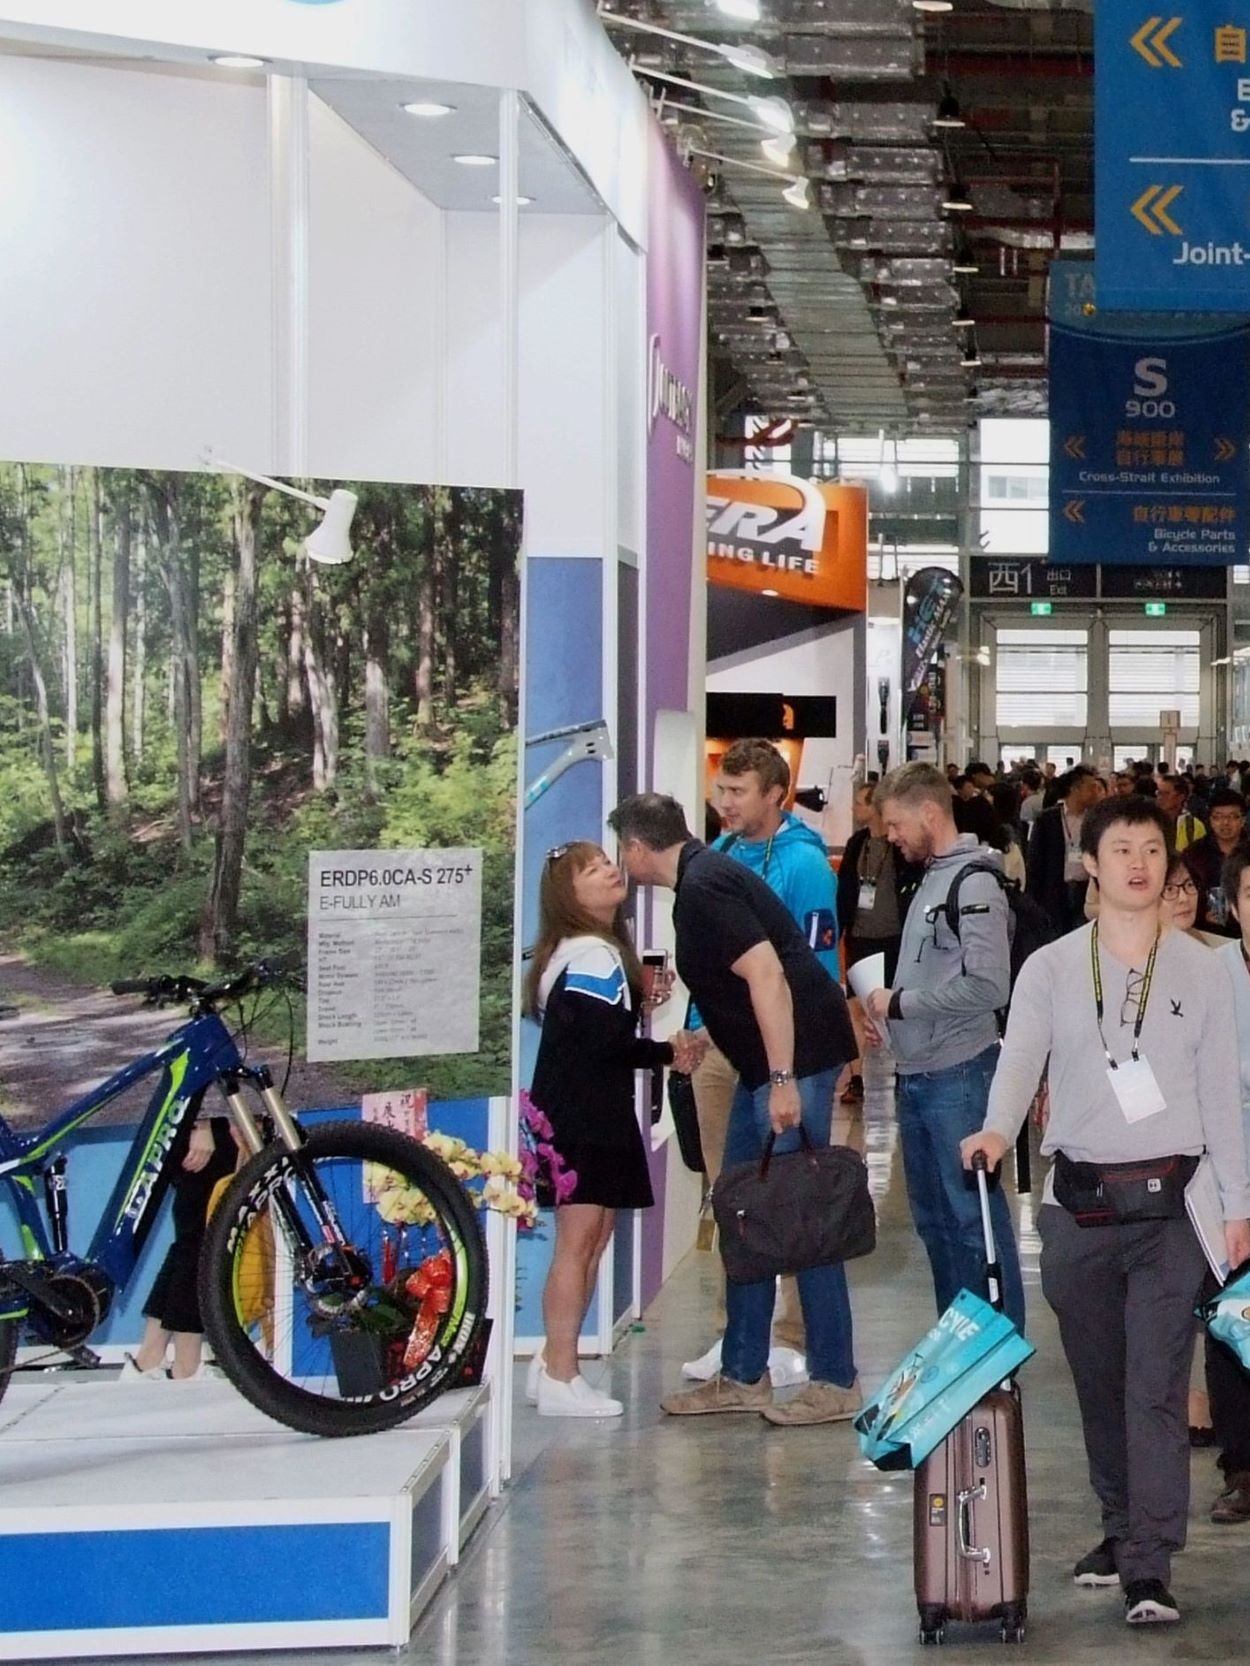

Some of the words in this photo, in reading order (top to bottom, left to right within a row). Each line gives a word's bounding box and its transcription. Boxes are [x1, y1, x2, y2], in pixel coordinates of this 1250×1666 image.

[1133, 357, 1169, 398] S
[1124, 400, 1176, 419] 900
[1078, 471, 1156, 483] Cross-Strait
[1160, 471, 1221, 484] Exhibition
[1153, 528, 1197, 542] Bicycle
[1200, 528, 1236, 541] Parts
[1162, 541, 1236, 554] Accessories
[761, 550, 822, 575] LIFE
[320, 868, 433, 888] ERDP6.0CA-S
[319, 894, 378, 911] E-FULLY
[379, 894, 401, 908] AM
[378, 1344, 443, 1401] APRO
